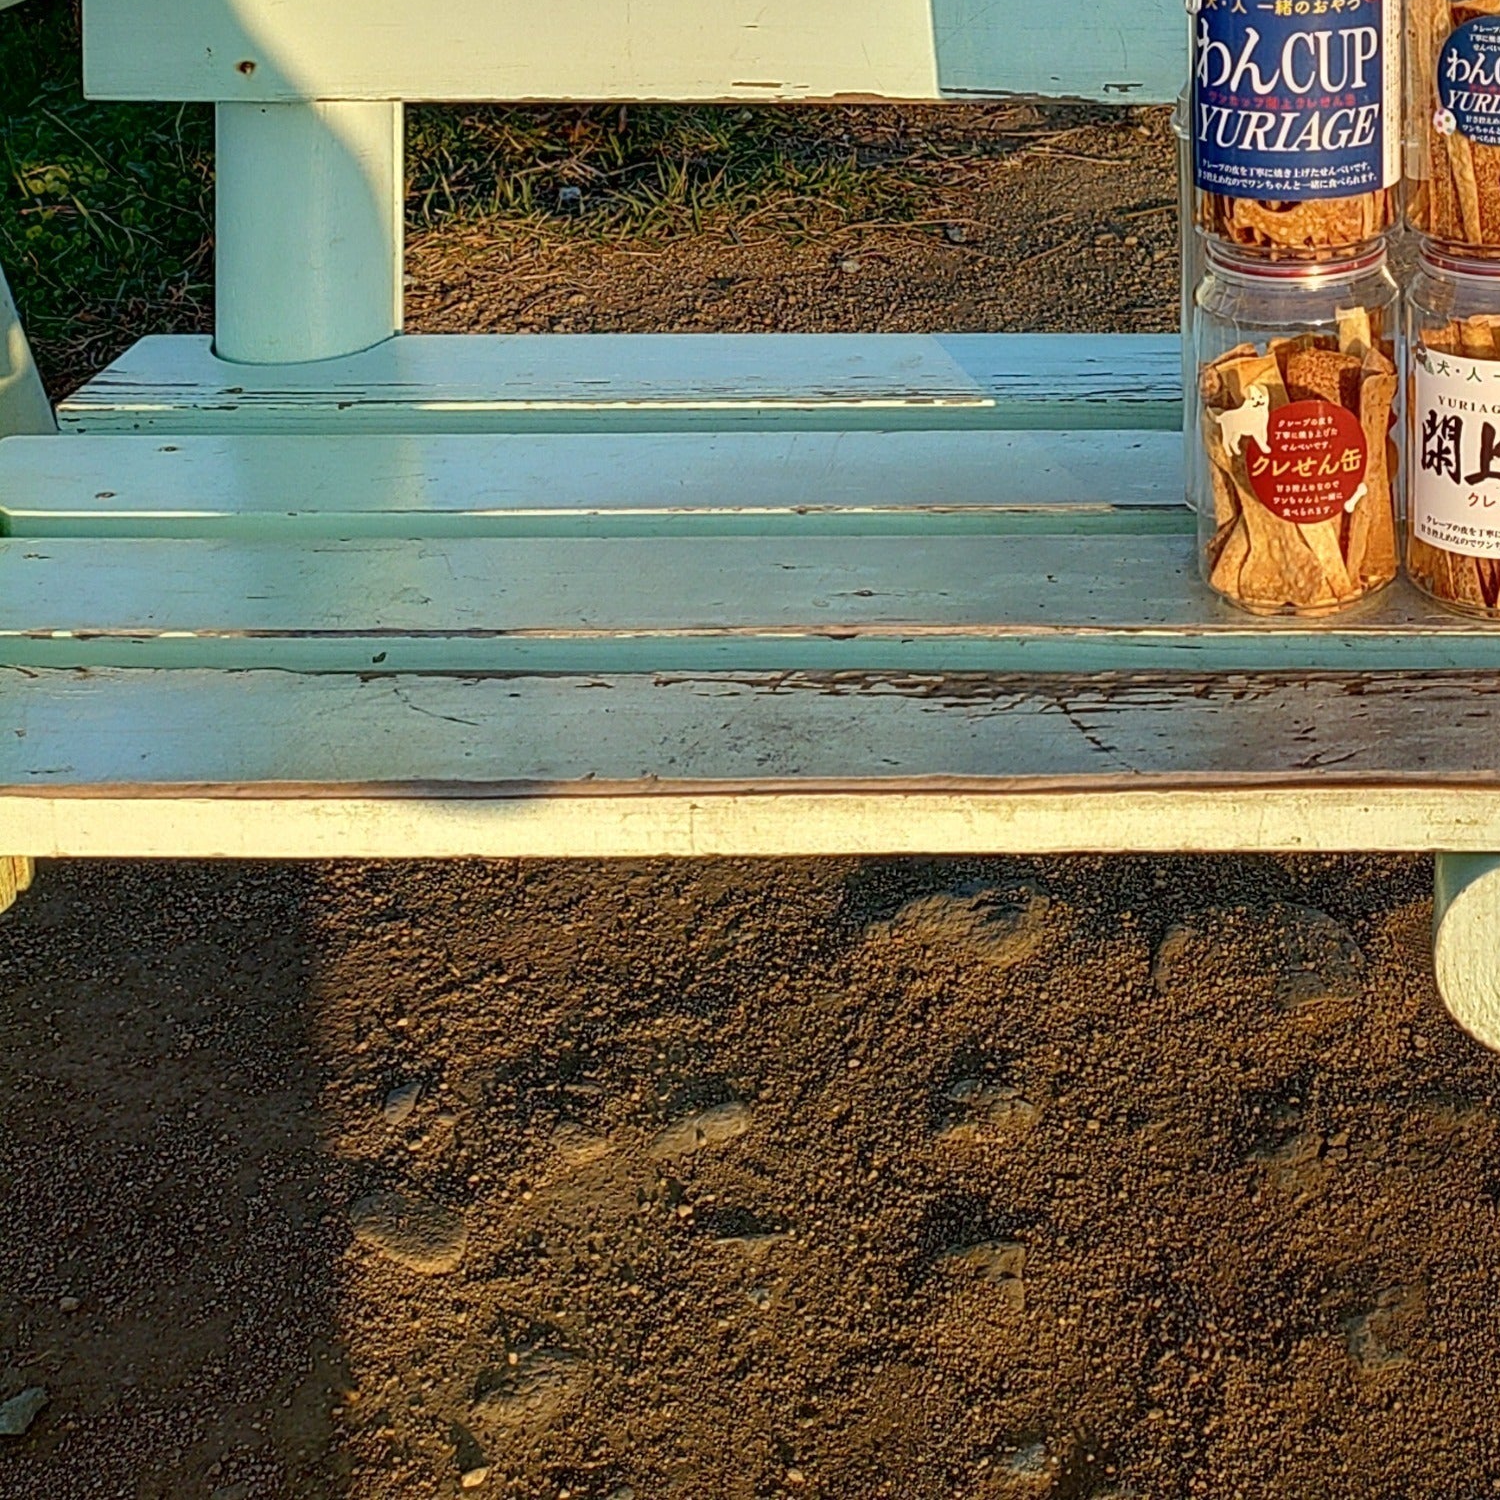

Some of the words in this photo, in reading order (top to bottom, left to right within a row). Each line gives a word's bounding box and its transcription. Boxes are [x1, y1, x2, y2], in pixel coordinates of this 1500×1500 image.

[1197, 17, 1378, 94] わんCUP
[1199, 103, 1380, 152] YURIAGE
[1252, 448, 1361, 477] クレせん缶
